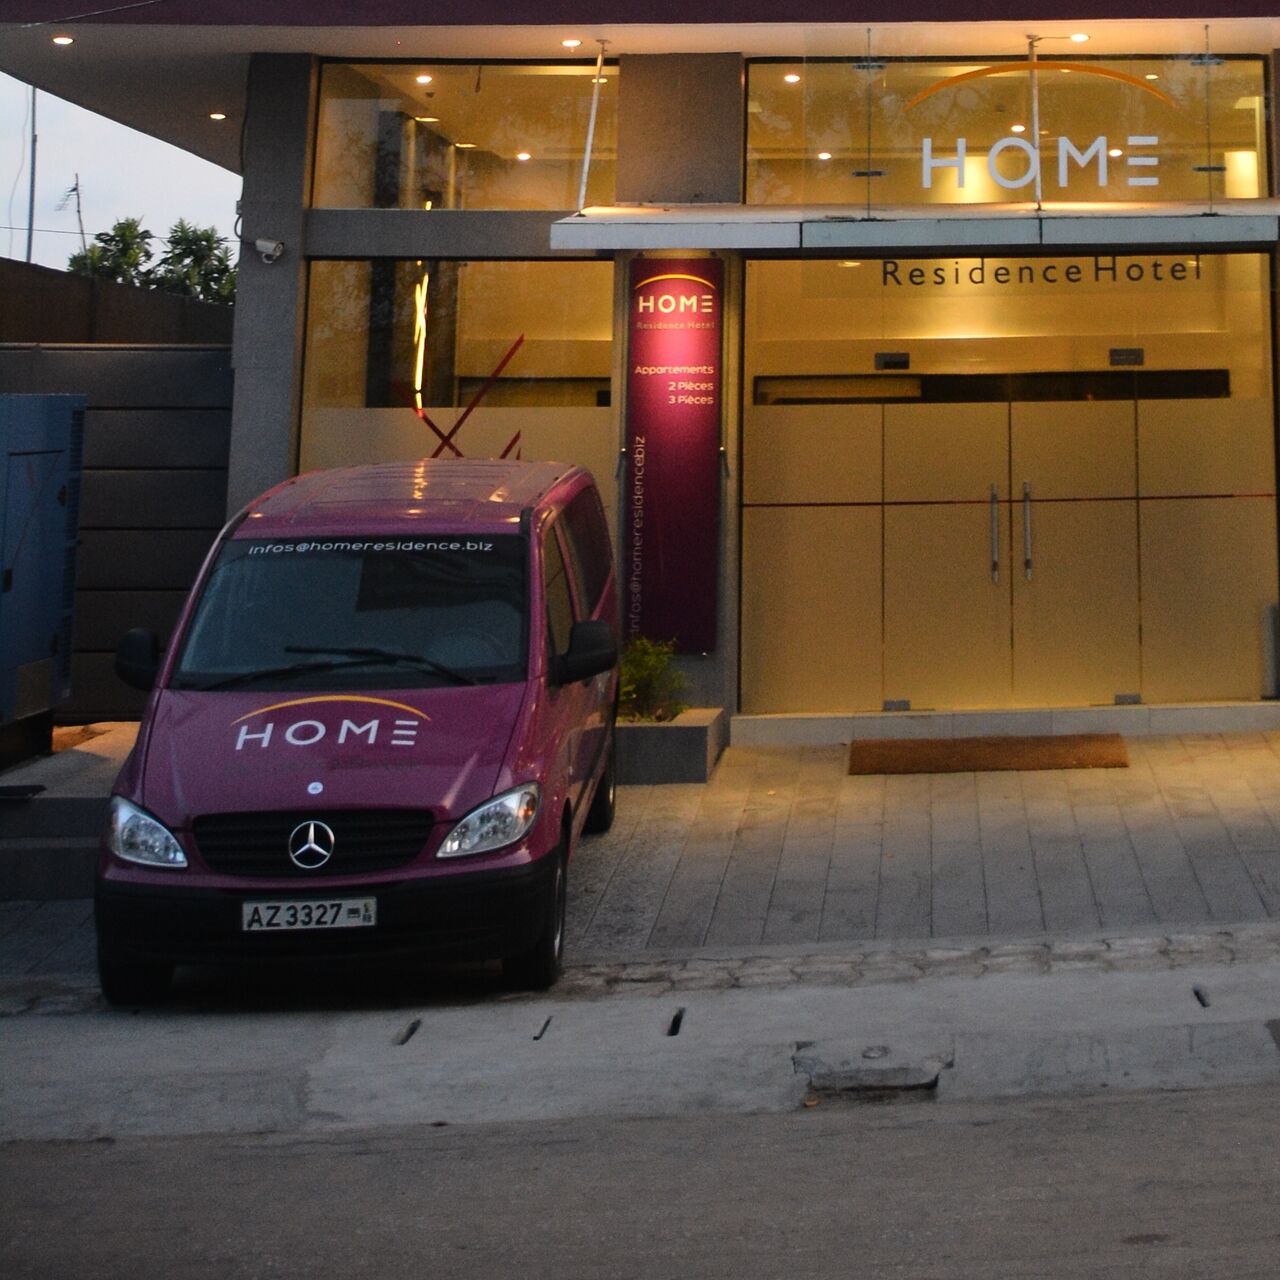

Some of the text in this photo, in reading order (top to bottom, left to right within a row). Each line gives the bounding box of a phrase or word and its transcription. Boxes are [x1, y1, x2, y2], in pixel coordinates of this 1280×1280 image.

[921, 136, 1159, 188] HOME
[639, 294, 713, 313] HOME
[636, 321, 715, 330] Residence Hotel
[635, 365, 714, 375] Appartements
[668, 381, 714, 391] 2 Pièces
[668, 395, 714, 405] 3 Pièces
[248, 541, 493, 555] infos@homeresidence.biz
[235, 719, 419, 750] HOME
